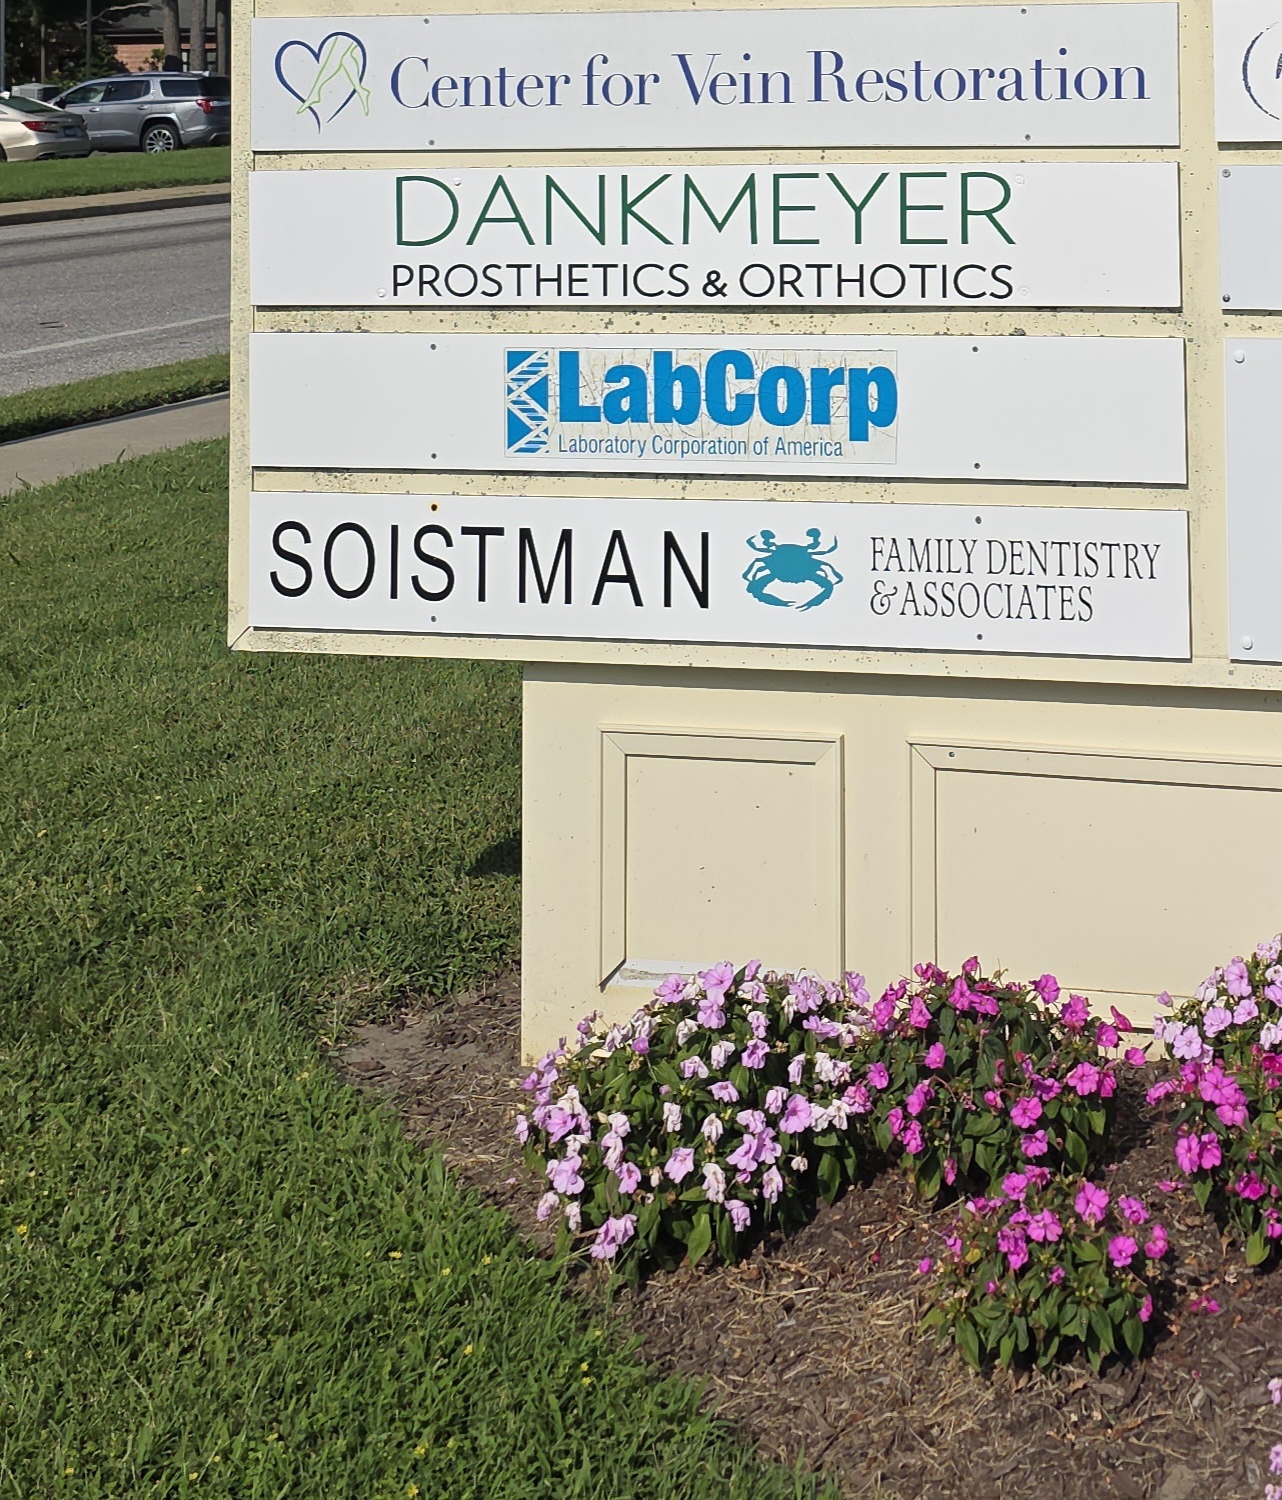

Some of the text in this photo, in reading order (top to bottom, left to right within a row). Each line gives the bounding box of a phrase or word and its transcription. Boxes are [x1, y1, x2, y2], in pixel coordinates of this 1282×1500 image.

[391, 48, 1150, 108] Center for Vein Restoration
[396, 172, 1016, 246] DANKMEYER
[391, 264, 1013, 300] PROSTHETICS & ORTHOTICS
[559, 349, 898, 442] LabCorp
[559, 434, 843, 458] Laboratory Corporation of America
[270, 521, 708, 609] SOISTMAN
[871, 537, 1161, 580] FAMILY DENTISTRY
